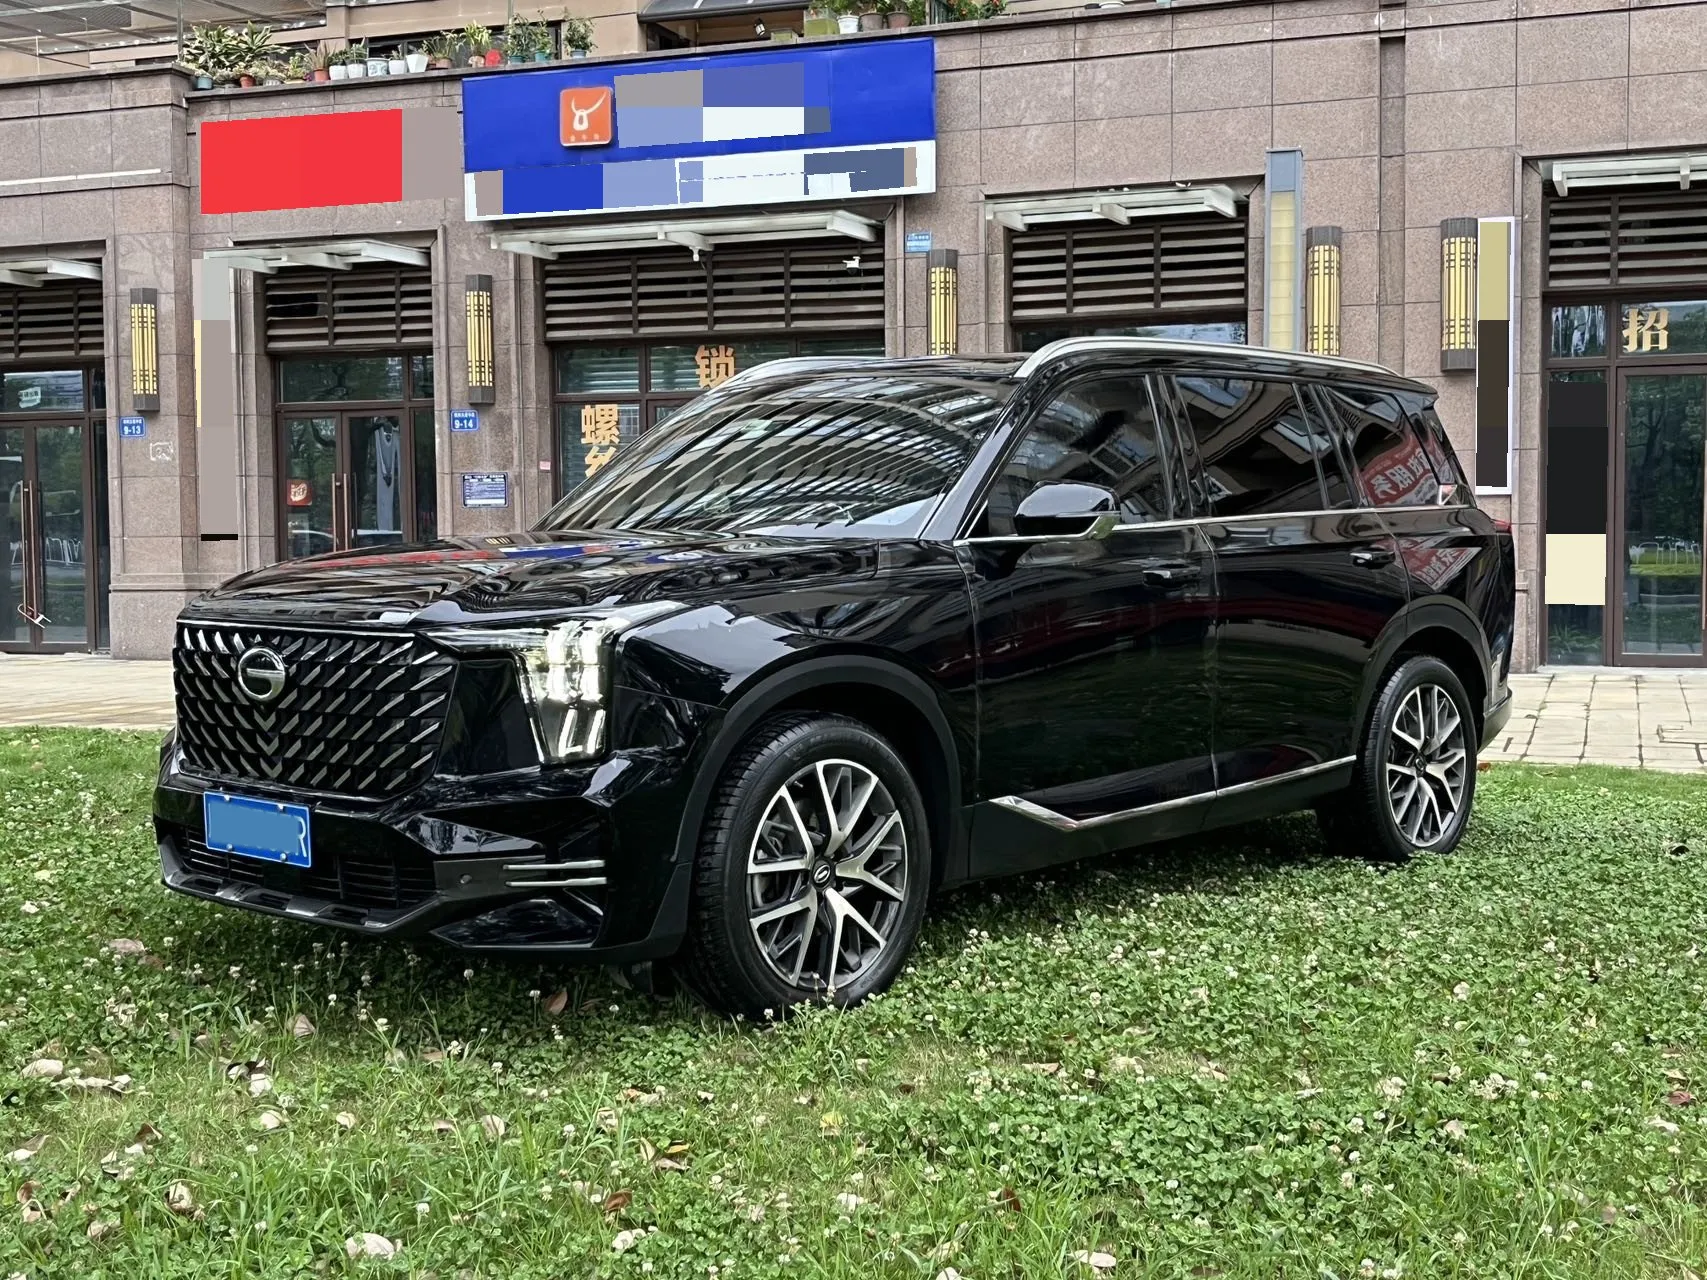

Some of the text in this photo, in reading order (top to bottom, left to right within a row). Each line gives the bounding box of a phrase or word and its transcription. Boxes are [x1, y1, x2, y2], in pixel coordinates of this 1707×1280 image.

[1622, 308, 1669, 352] 招
[695, 345, 735, 389] 锁
[124, 425, 141, 435] 9-13
[454, 419, 473, 429] 9-14
